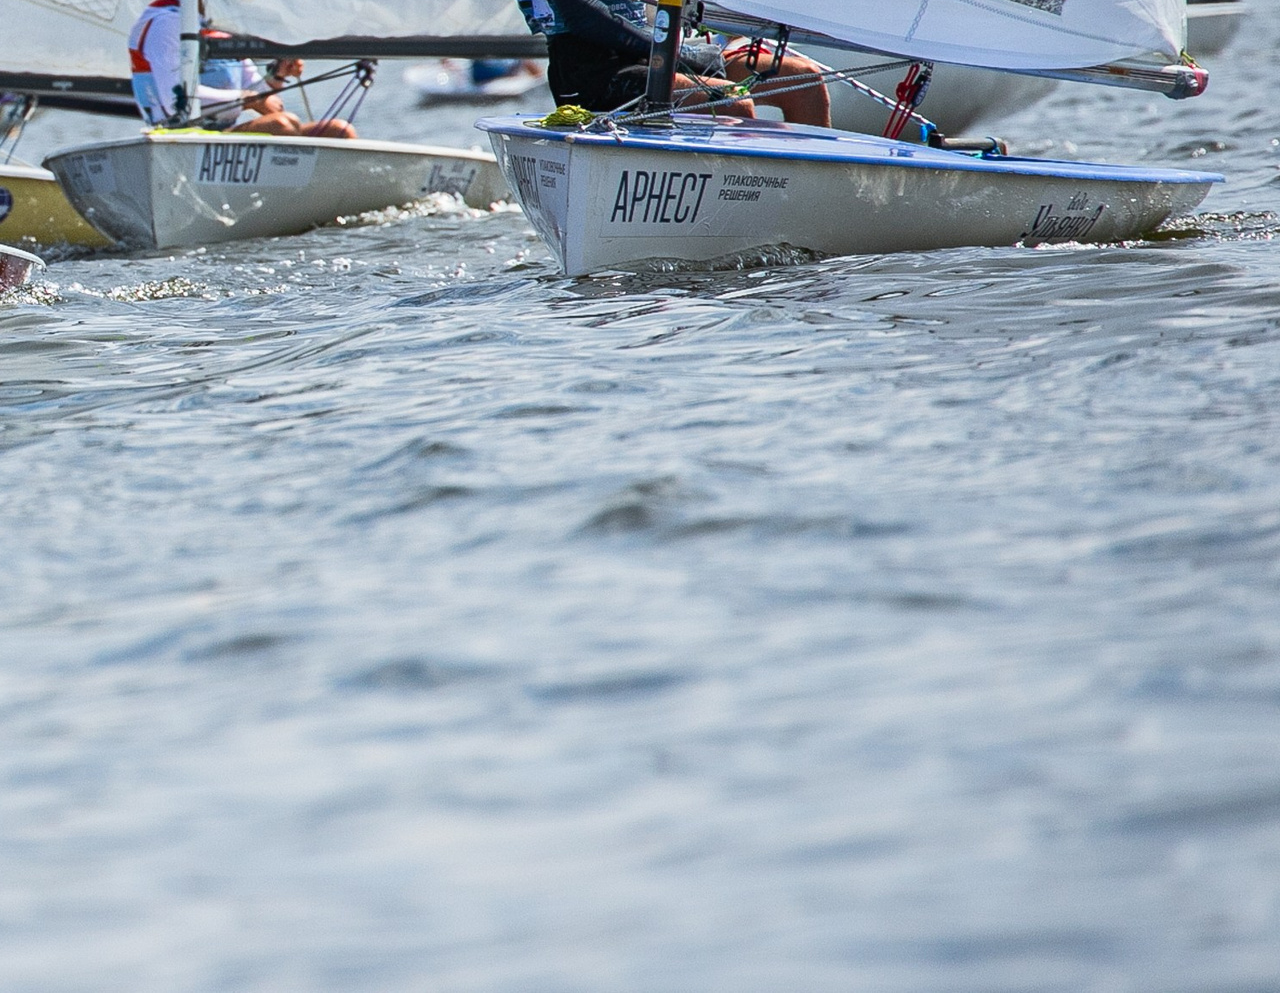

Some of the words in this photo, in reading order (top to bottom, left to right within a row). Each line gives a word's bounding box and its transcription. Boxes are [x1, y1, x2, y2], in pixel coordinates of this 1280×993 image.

[199, 143, 267, 184] АРНЕСТ
[611, 170, 712, 223] АРНЕСТ
[723, 174, 789, 189] УПАКОВОЧНЫЕ
[718, 189, 761, 202] РЕШЕНИЯ
